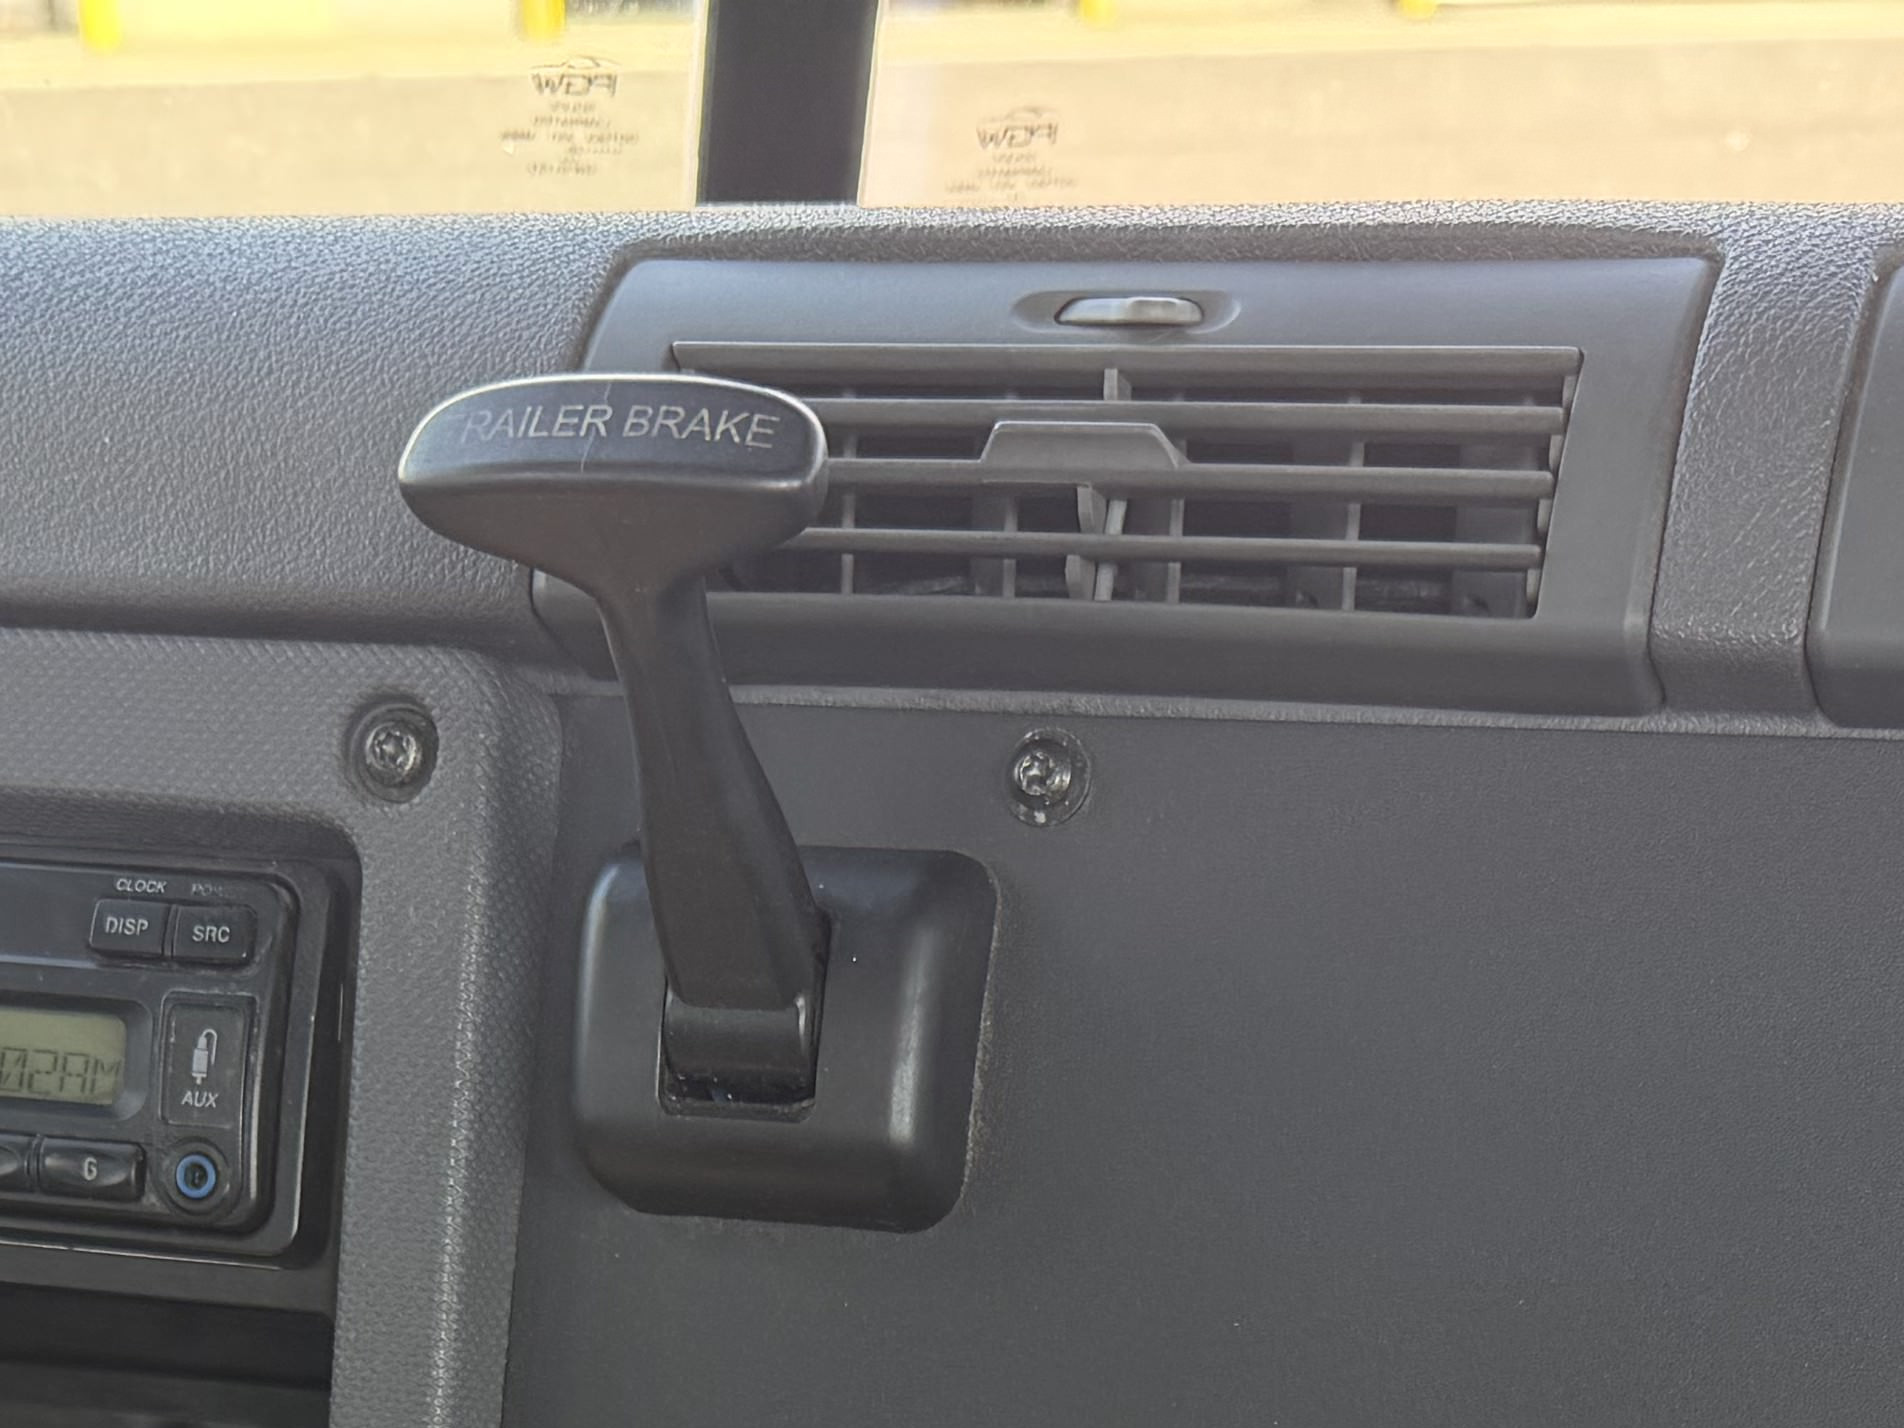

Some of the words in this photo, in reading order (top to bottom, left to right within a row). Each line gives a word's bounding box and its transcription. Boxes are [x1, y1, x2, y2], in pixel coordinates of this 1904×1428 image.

[623, 404, 781, 449] BRAKE
[115, 877, 168, 894] CLOCK
[104, 915, 149, 937] DISP
[192, 923, 231, 944] SRC
[181, 1090, 218, 1109] AUX
[83, 1157, 97, 1180] 6
